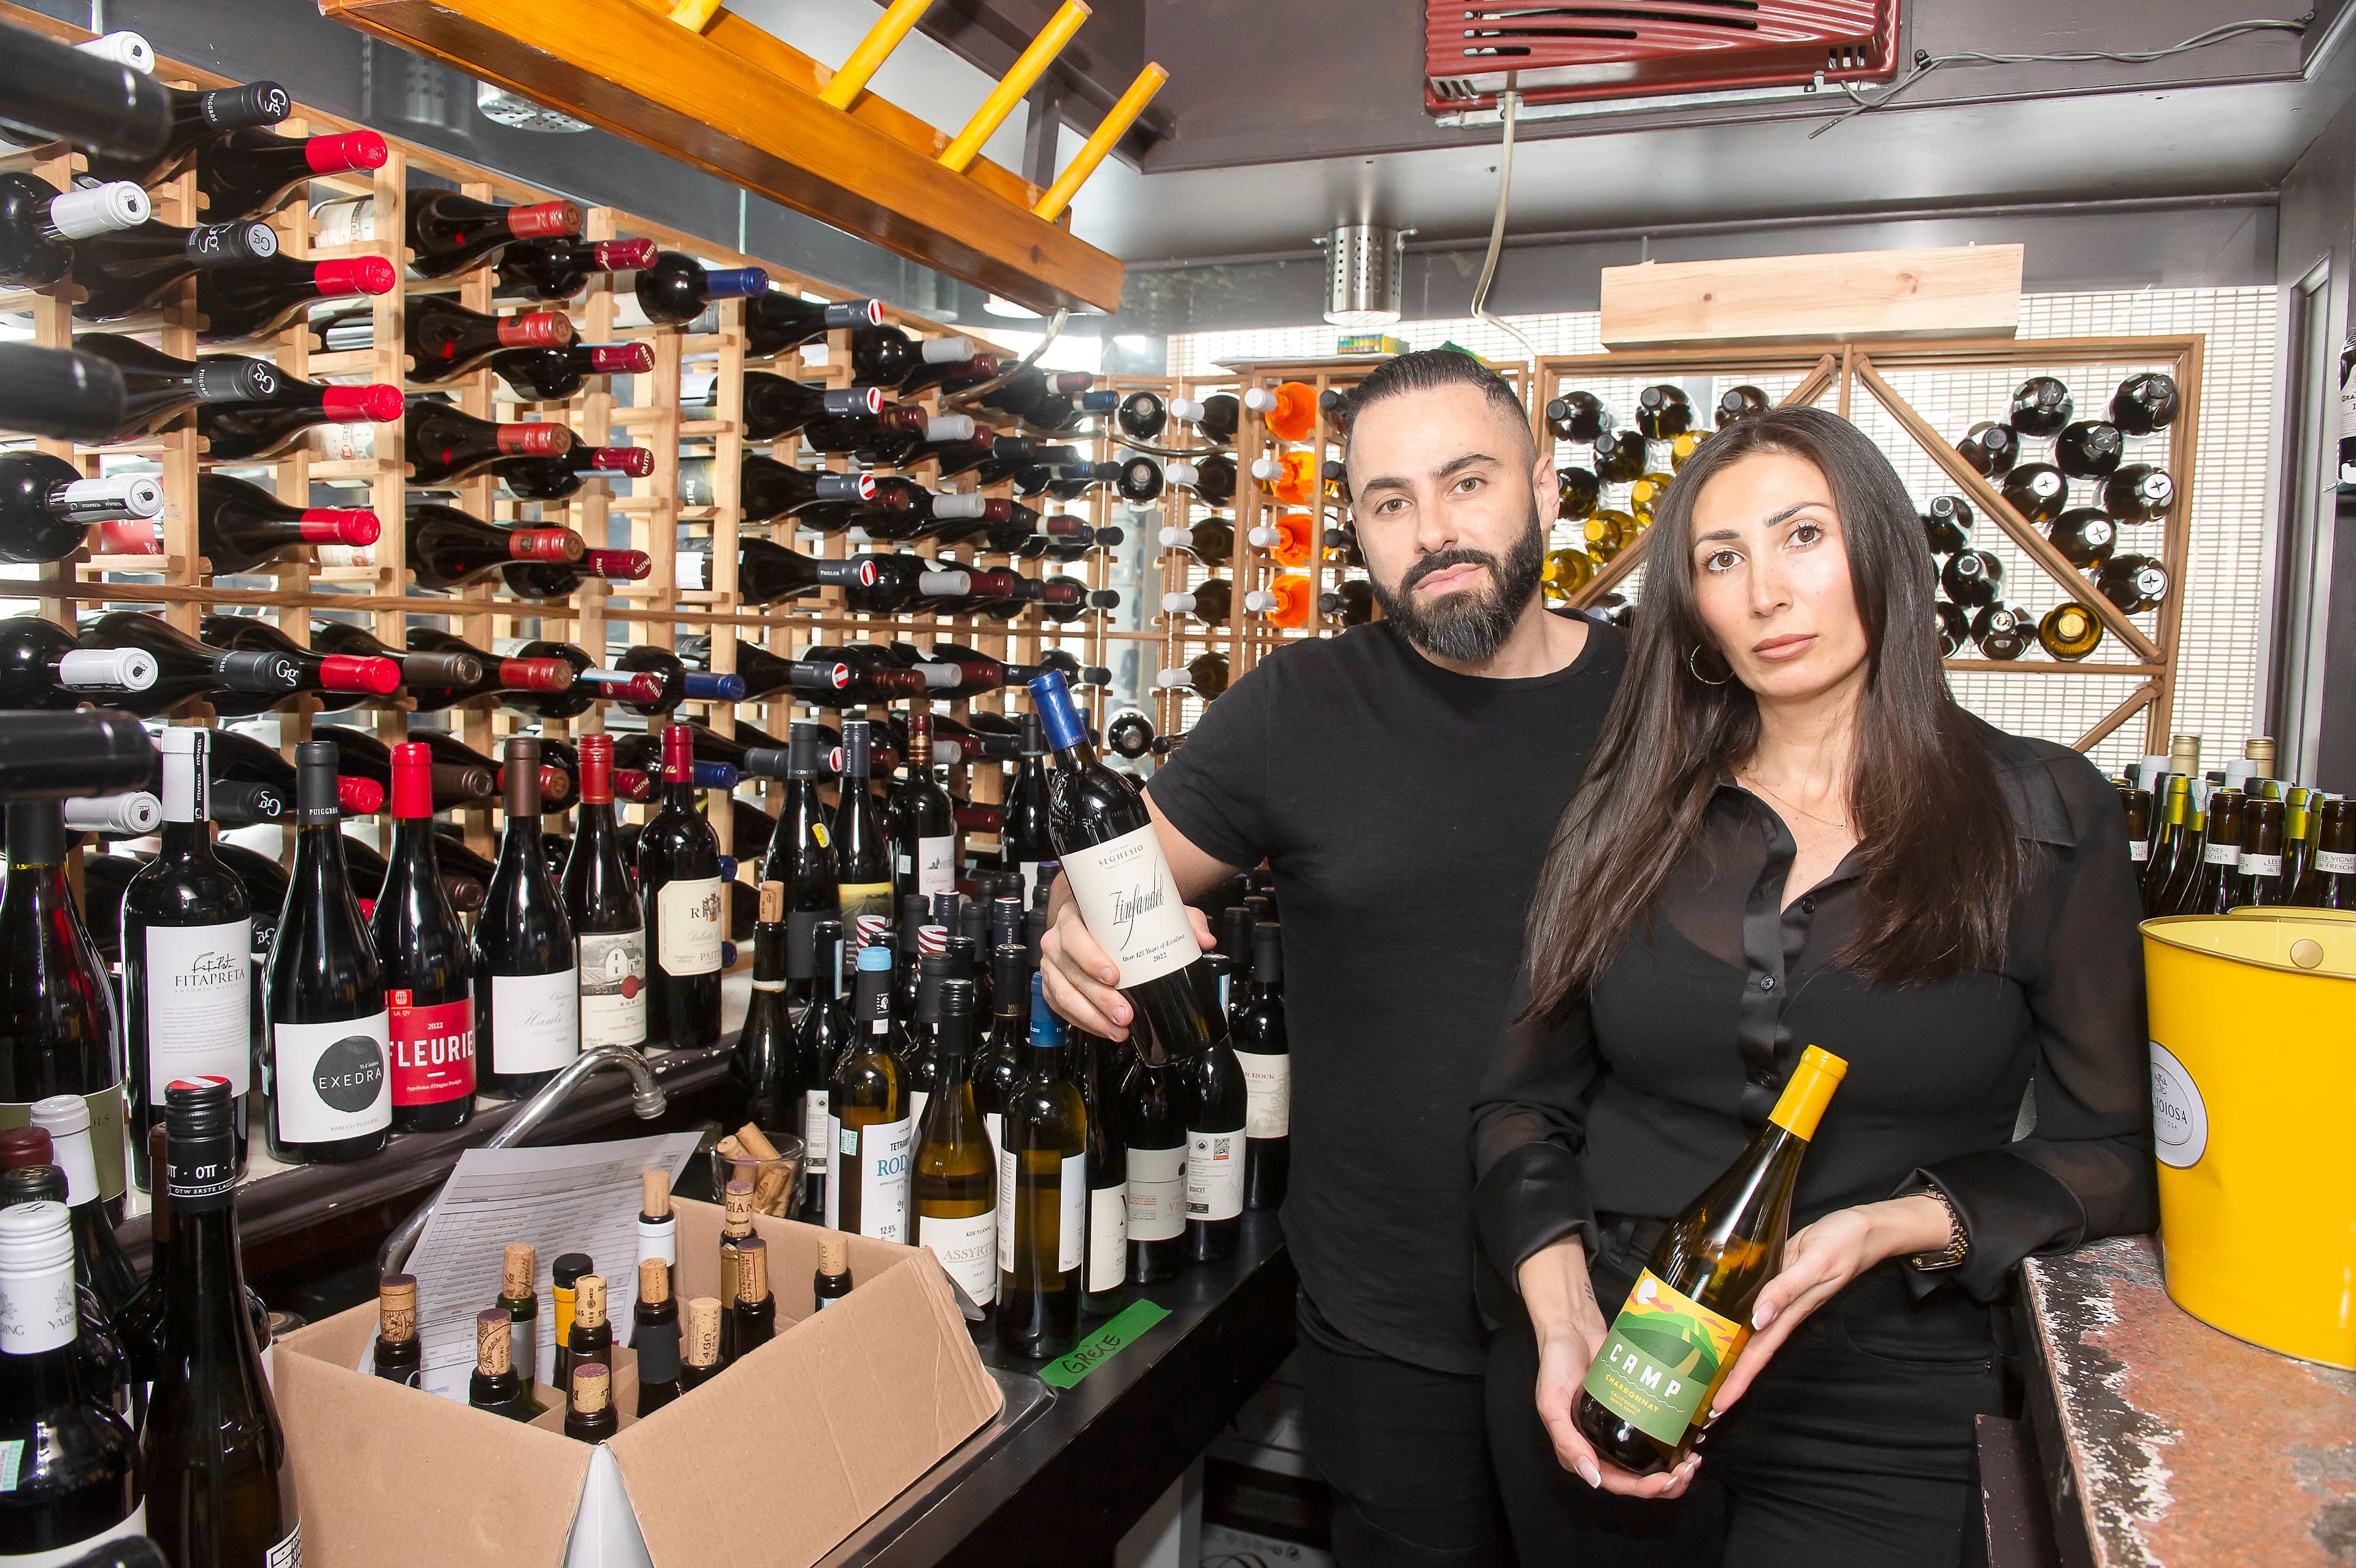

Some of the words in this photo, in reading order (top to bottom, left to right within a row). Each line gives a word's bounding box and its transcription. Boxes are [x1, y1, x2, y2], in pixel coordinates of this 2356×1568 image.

[1098, 844, 1144, 867] SEGHESIO
[1122, 954, 1134, 963] Over
[1145, 945, 1160, 956] Years
[1160, 941, 1166, 950] of
[1153, 952, 1168, 963] 2022
[175, 968, 245, 987] FITAPRETA
[427, 1021, 444, 1030] 2022
[318, 1067, 383, 1090] EXEDRA
[196, 1164, 218, 1179] OTT
[193, 1185, 217, 1194] ERSTE
[1609, 1342, 1682, 1398] CAMP
[1605, 1374, 1660, 1412] CHARDONNAY
[1610, 1390, 1641, 1413] CALIFORNIA
